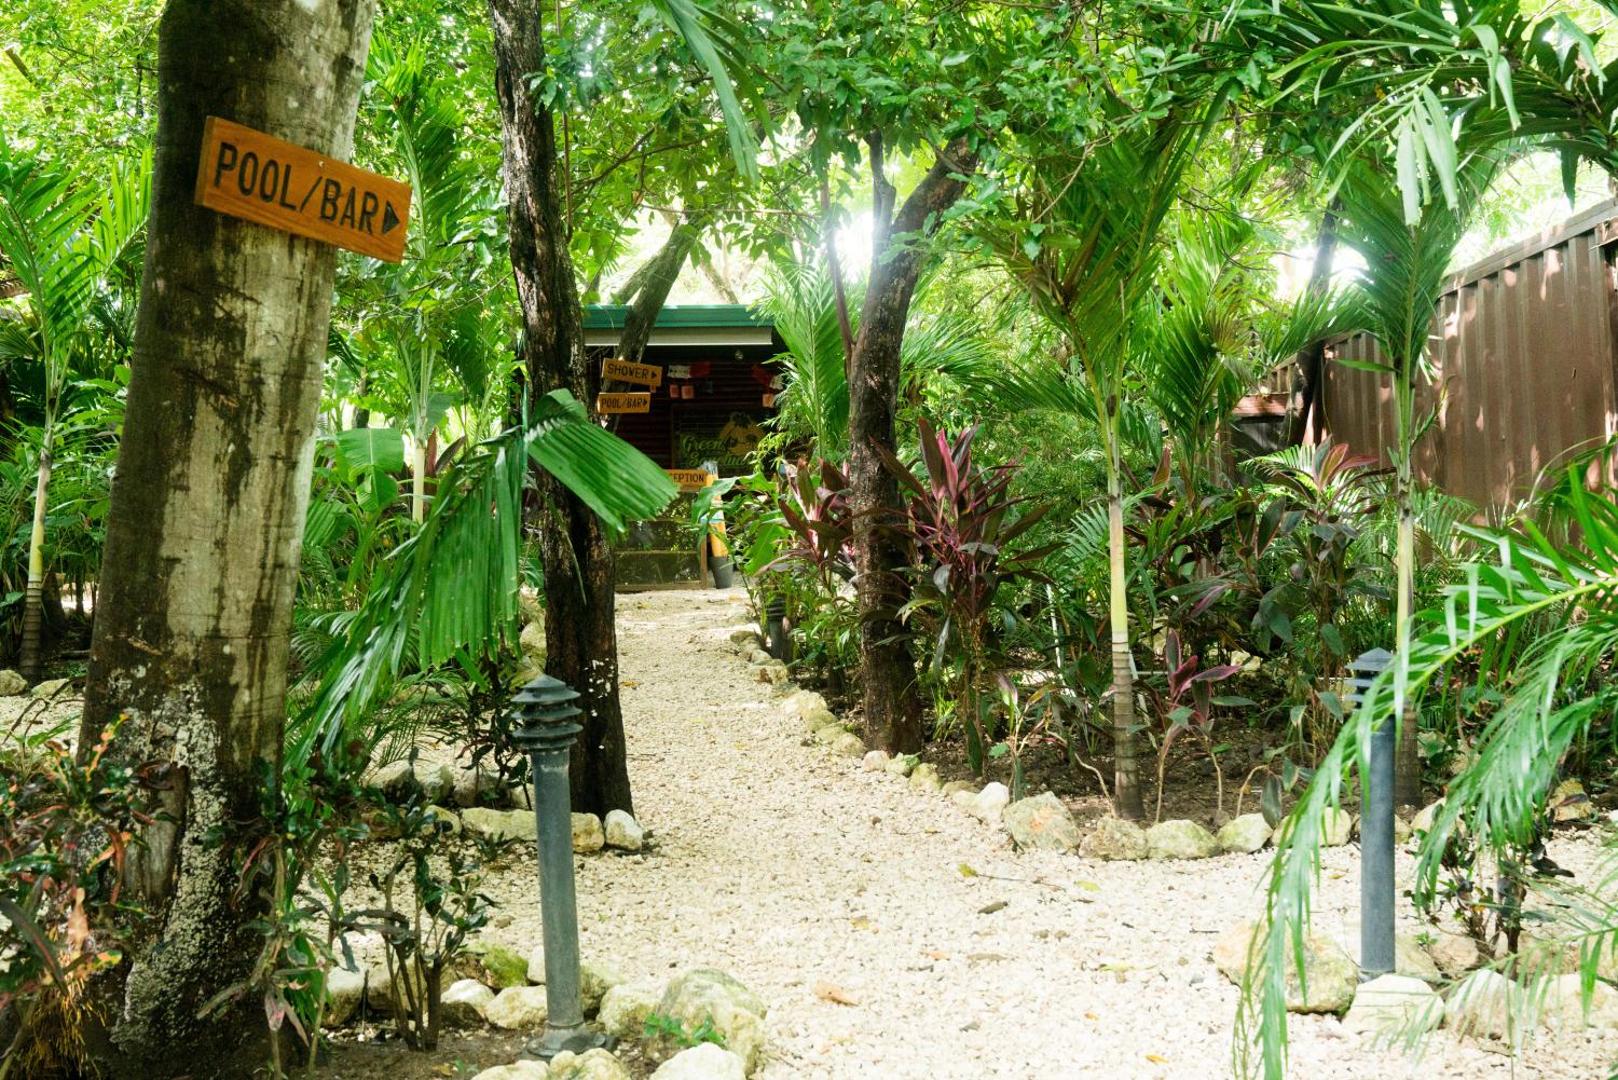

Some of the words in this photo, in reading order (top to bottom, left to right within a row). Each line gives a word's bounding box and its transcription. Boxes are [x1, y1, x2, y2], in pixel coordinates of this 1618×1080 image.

[214, 142, 379, 235] POOL/BAR
[601, 398, 642, 409] POOL/BAR
[682, 435, 725, 452] Green
[669, 472, 705, 483] EPTION
